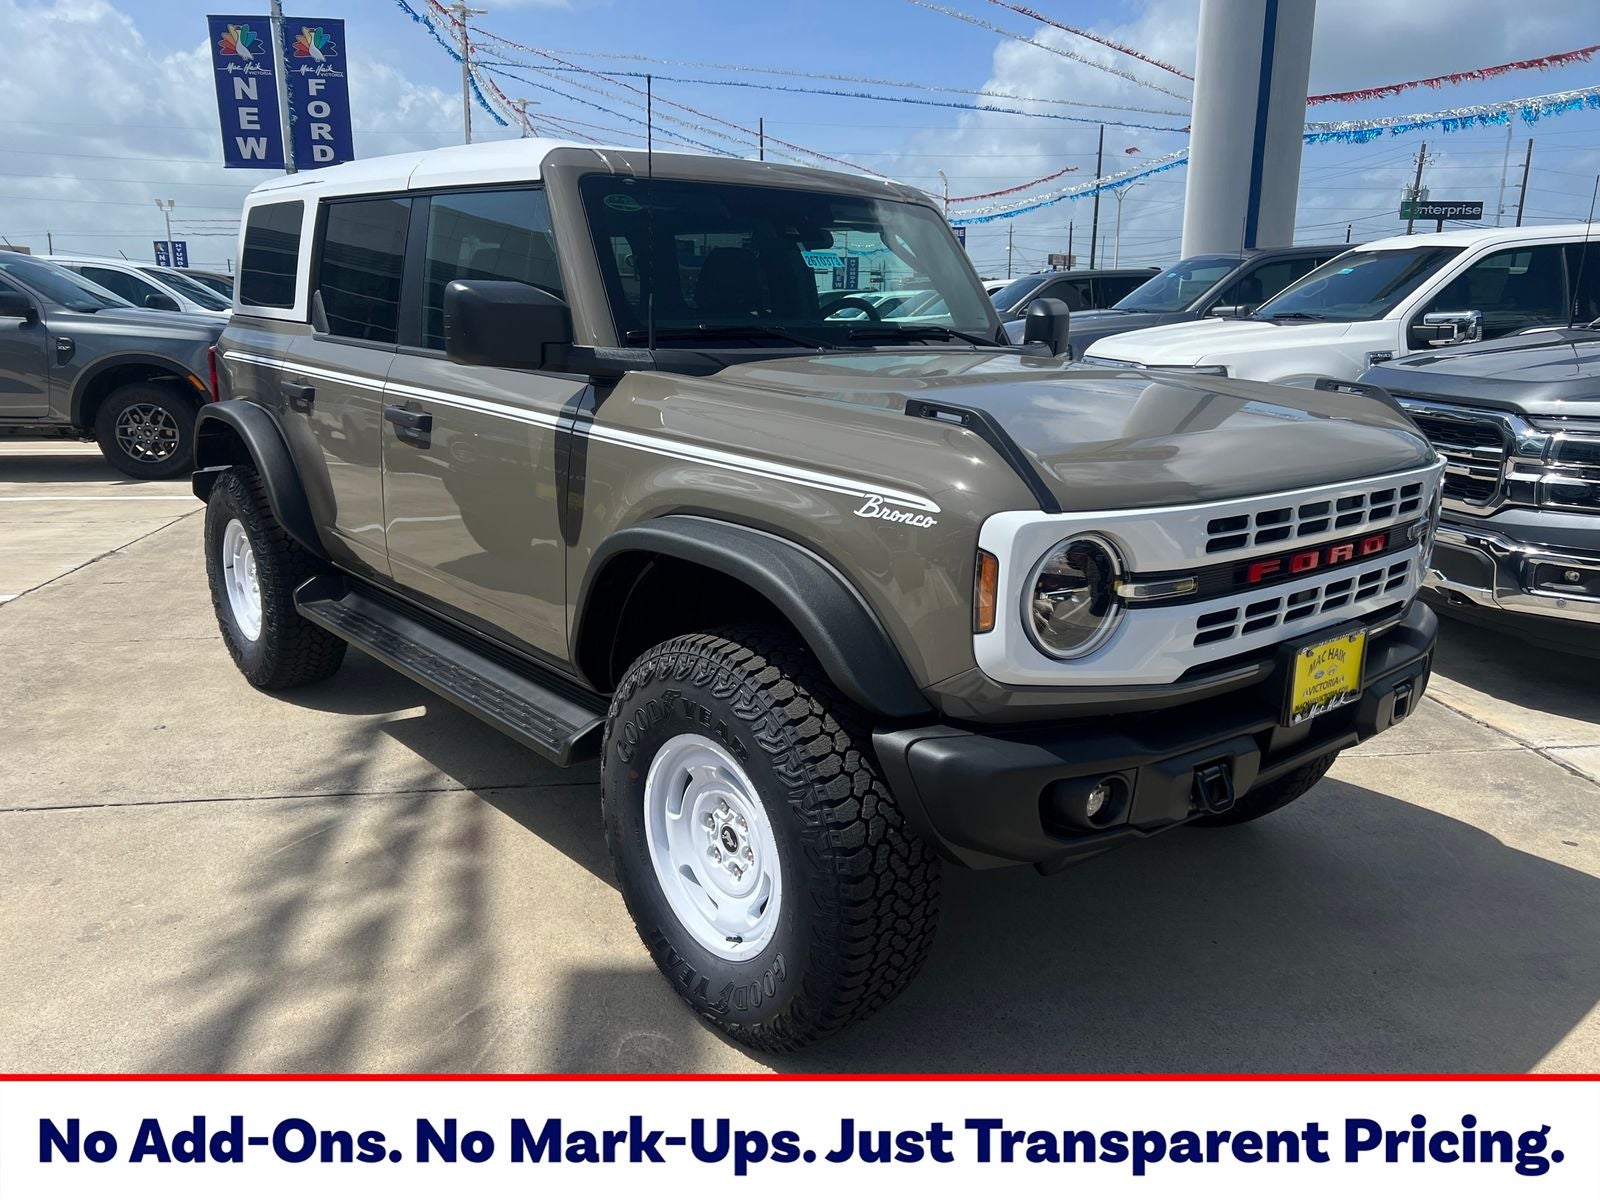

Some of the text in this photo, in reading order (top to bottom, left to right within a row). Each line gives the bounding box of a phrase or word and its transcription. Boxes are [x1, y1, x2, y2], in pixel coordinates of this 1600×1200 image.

[233, 77, 268, 160] NEW
[307, 78, 335, 162] FORD
[853, 493, 938, 528] Bronco
[1248, 533, 1386, 583] FORD
[1308, 651, 1327, 677] MAC
